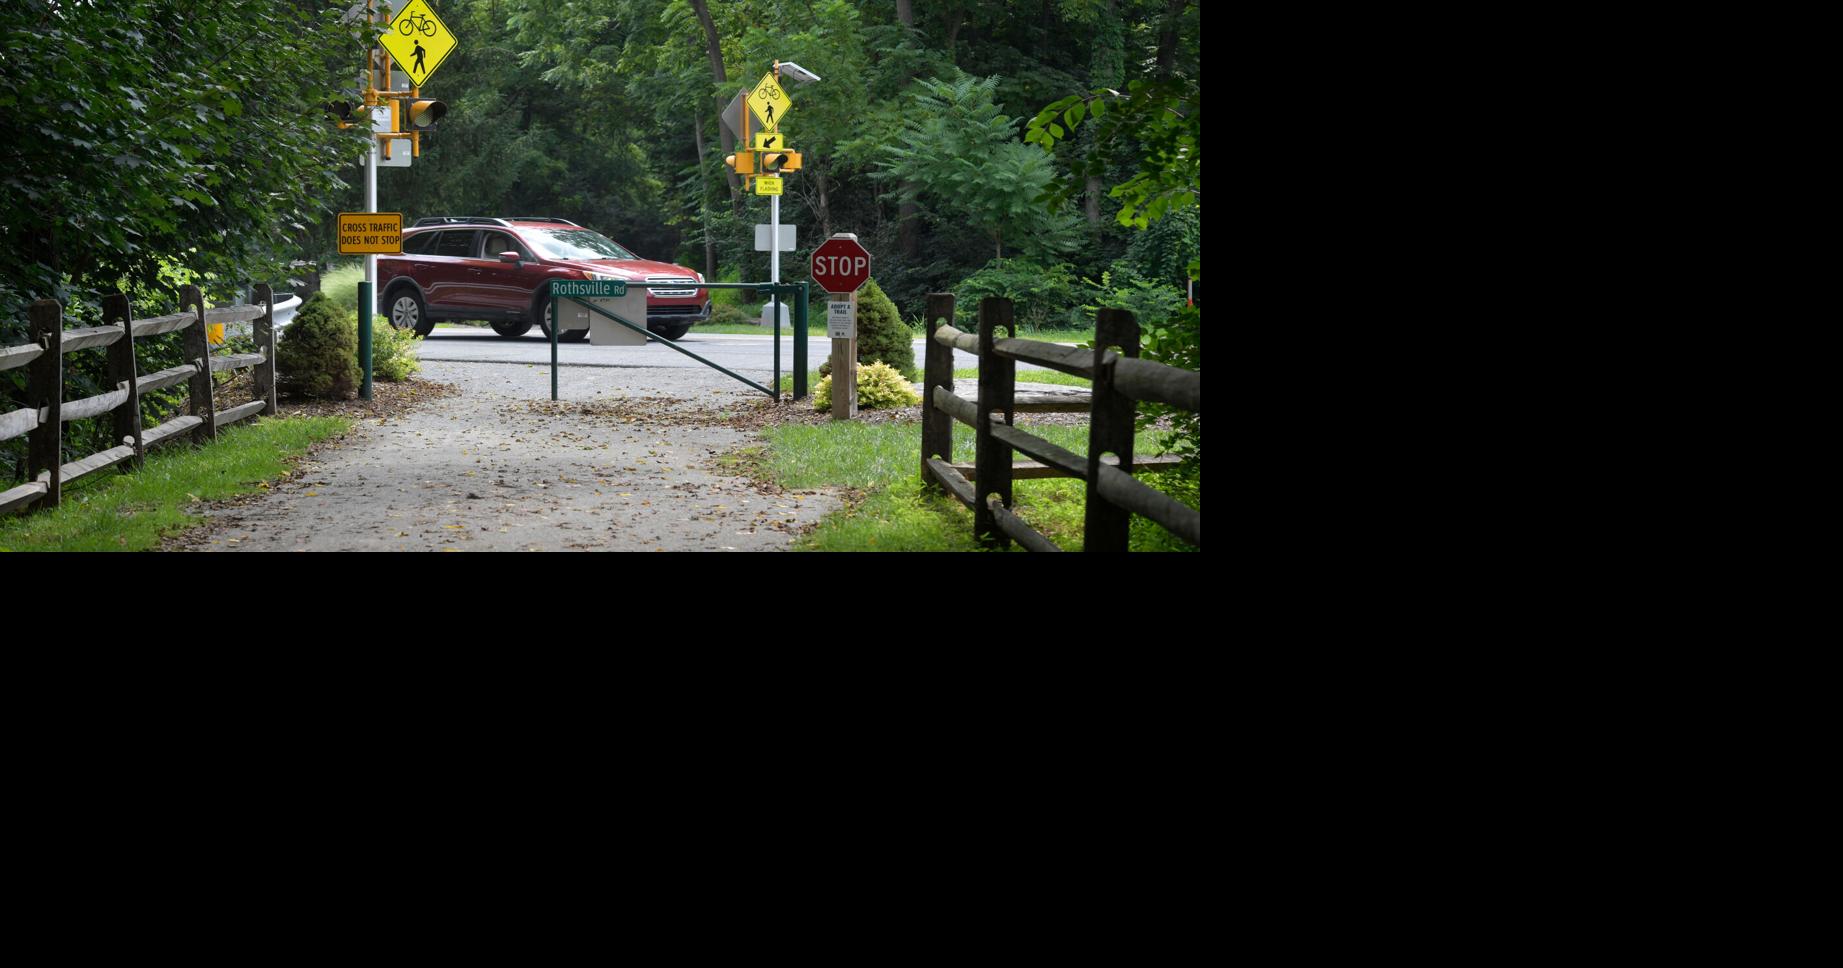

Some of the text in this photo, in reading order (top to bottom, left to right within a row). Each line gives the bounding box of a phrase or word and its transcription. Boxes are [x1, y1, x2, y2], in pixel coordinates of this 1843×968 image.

[342, 223, 398, 232] CROSS TRAFFIC
[341, 235, 400, 245] DOES NOT STOP
[815, 255, 867, 276] STOP
[552, 281, 625, 295] Rothsville Rd
